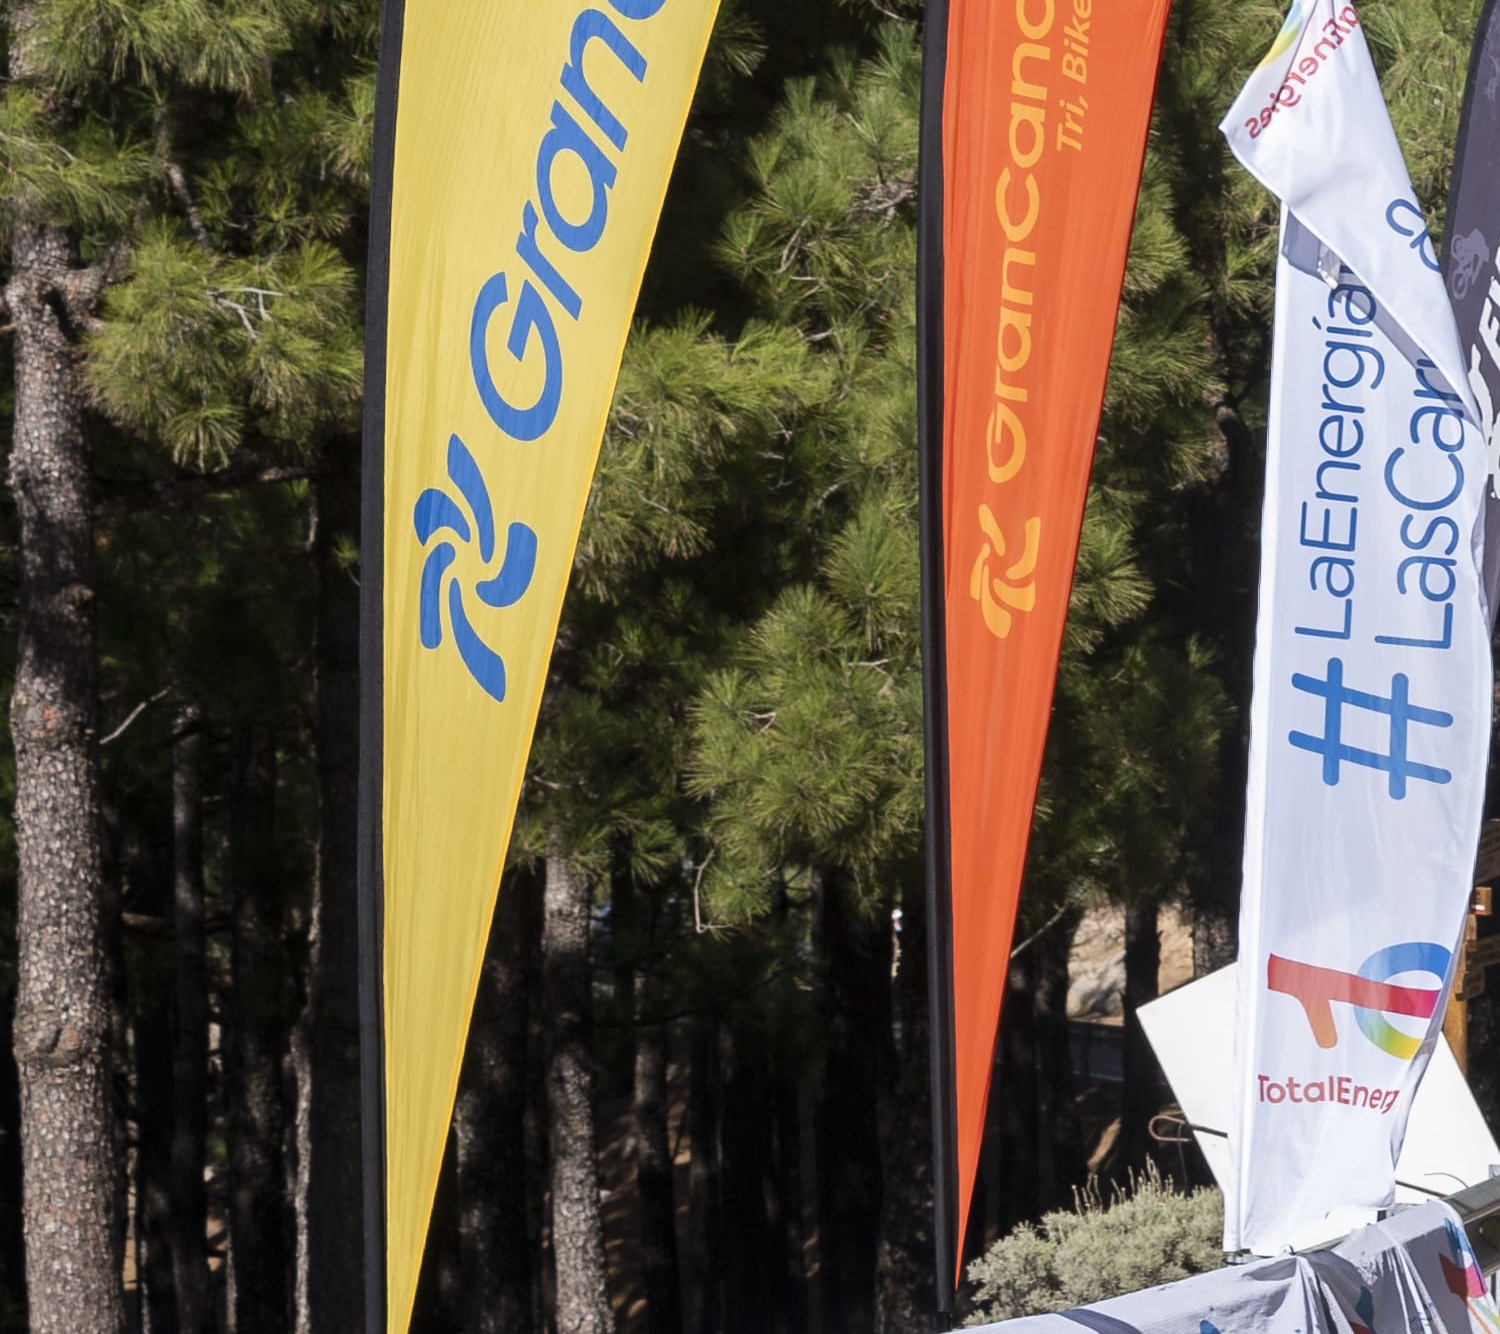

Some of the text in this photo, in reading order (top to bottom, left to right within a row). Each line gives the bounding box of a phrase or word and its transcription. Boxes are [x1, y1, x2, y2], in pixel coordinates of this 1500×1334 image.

[1056, 93, 1089, 153] Tri,
[1294, 267, 1385, 641] LaEnergía
[1374, 357, 1466, 650] LasCar
